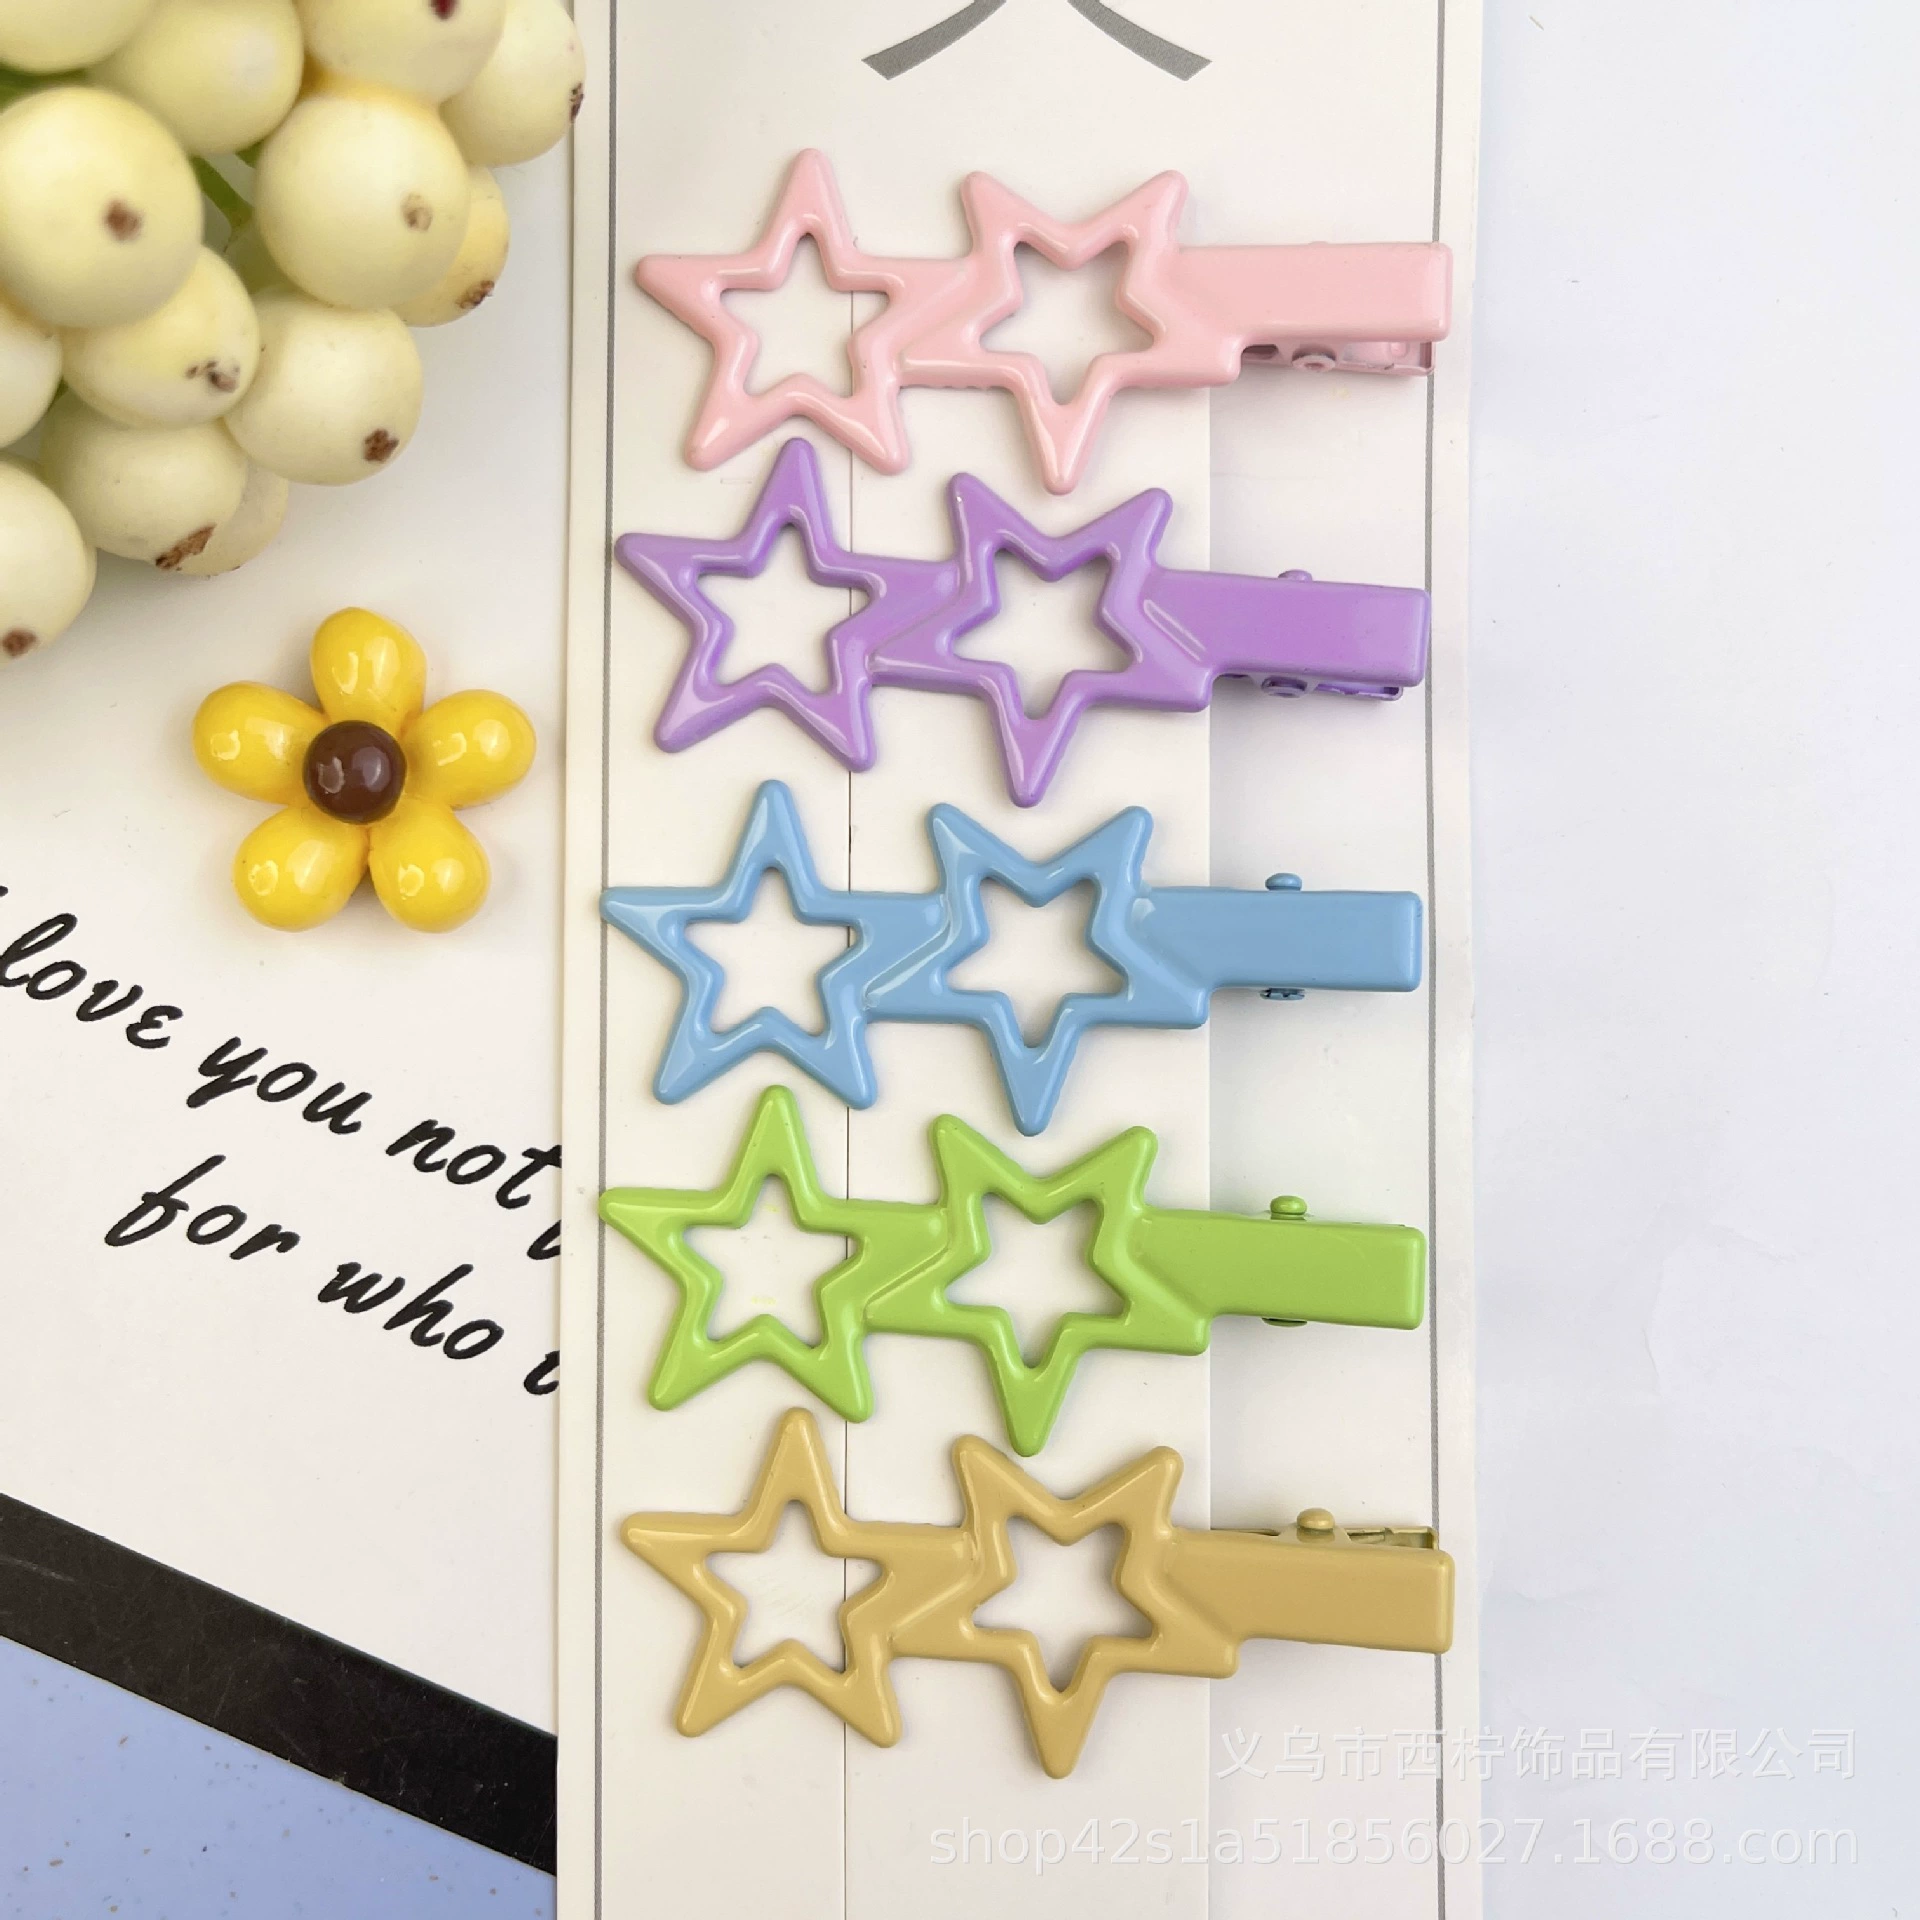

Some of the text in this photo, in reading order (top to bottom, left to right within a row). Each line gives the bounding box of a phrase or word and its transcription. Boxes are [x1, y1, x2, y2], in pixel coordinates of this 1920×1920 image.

[0, 913, 562, 1210] love you not
[104, 1155, 504, 1360] for who
